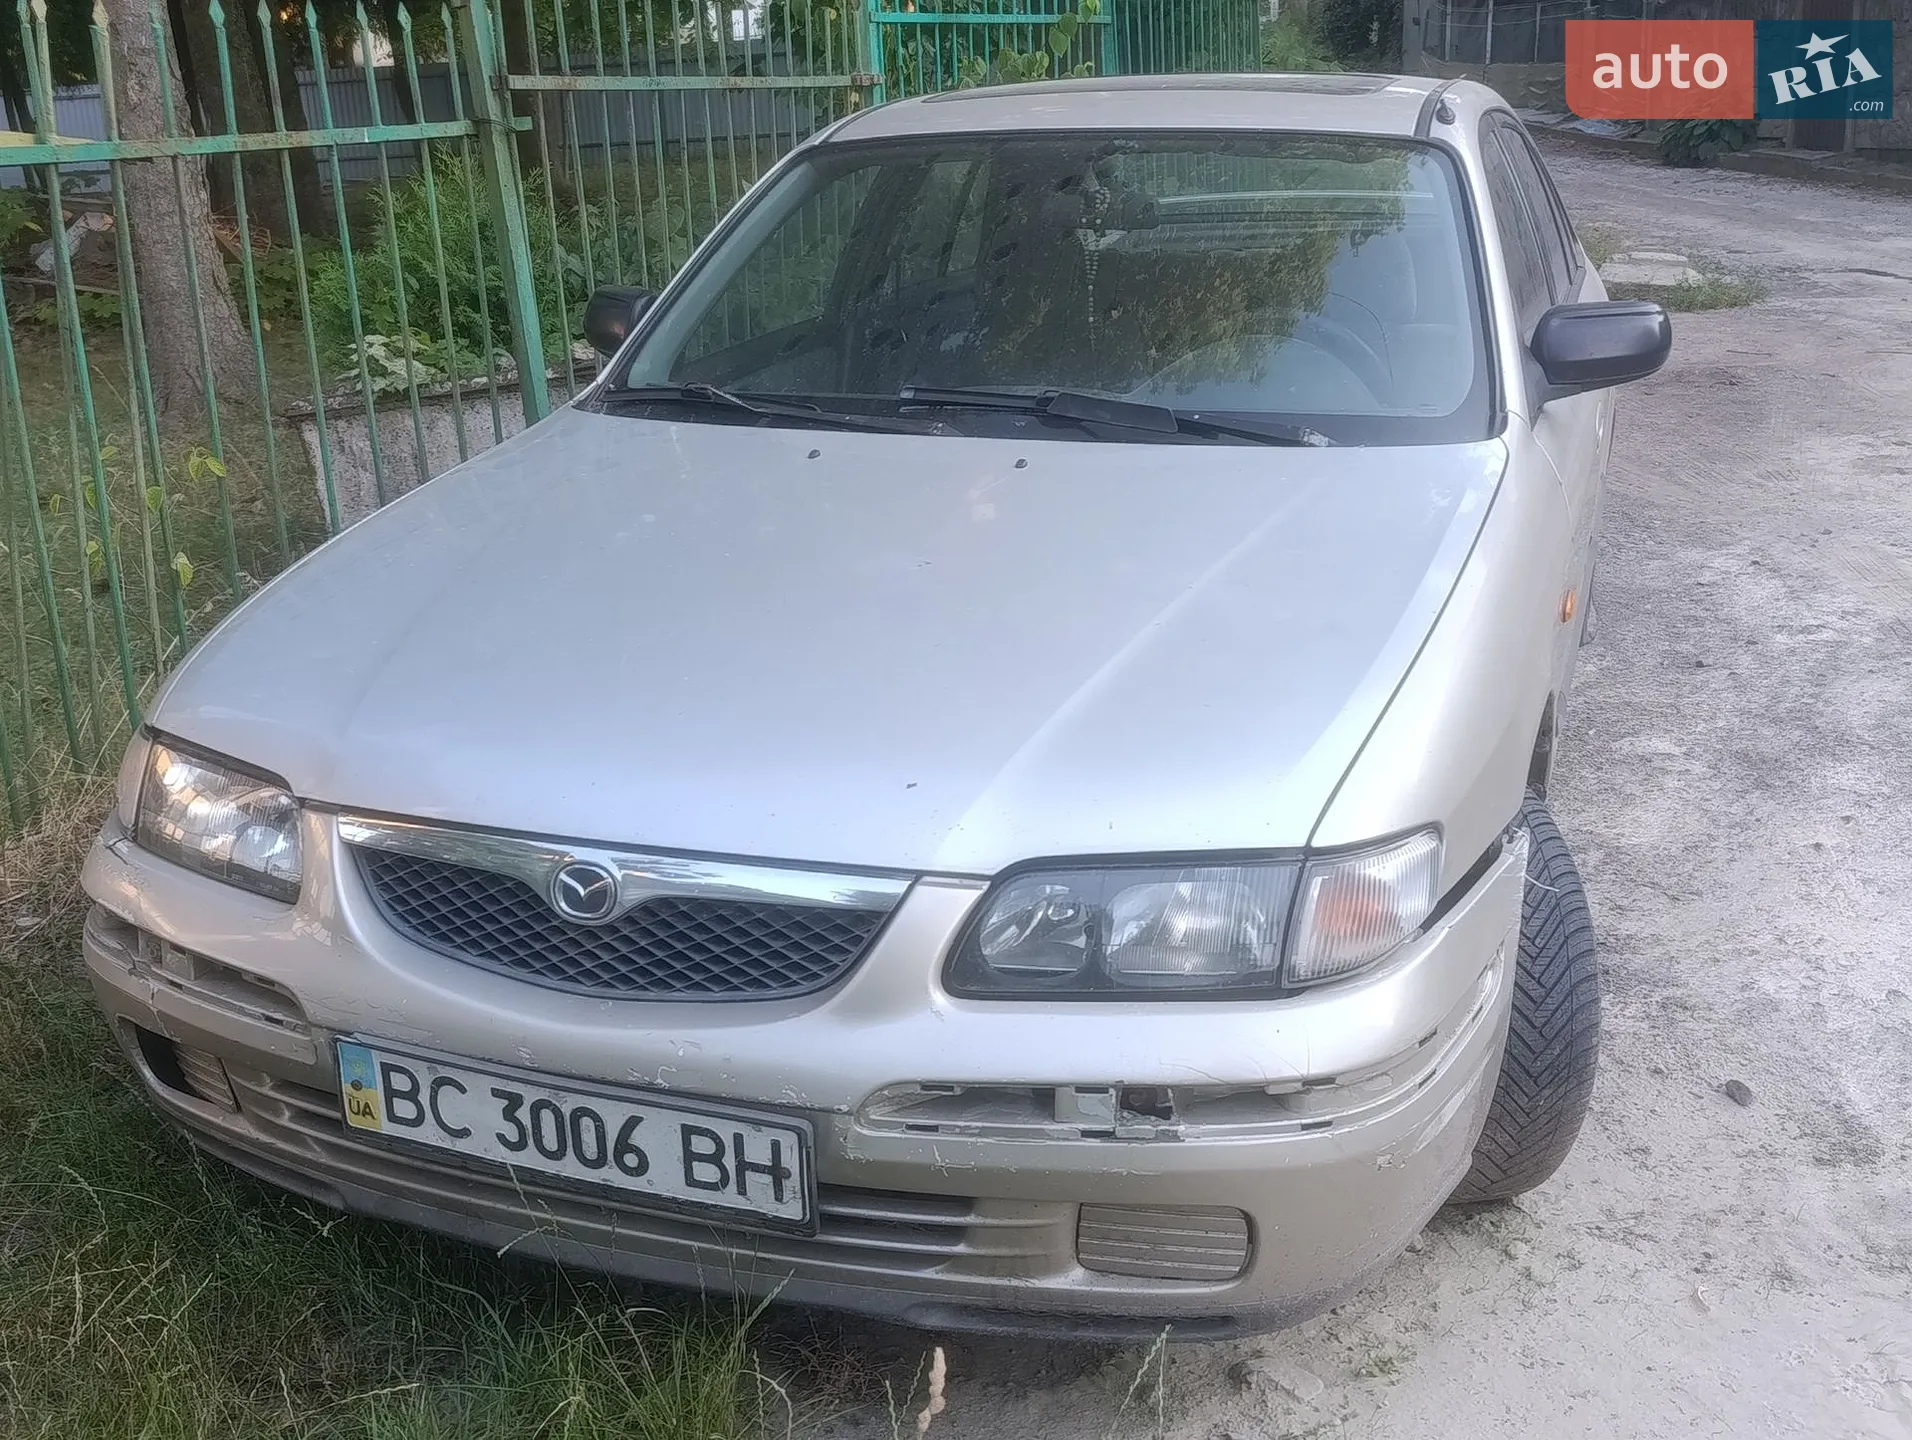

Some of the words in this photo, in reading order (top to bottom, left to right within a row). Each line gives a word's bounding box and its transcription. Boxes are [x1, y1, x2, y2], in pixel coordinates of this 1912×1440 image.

[348, 1096, 377, 1121] UA
[379, 1060, 472, 1139] BC
[490, 1086, 650, 1178] 3006
[681, 1122, 785, 1203] BH
